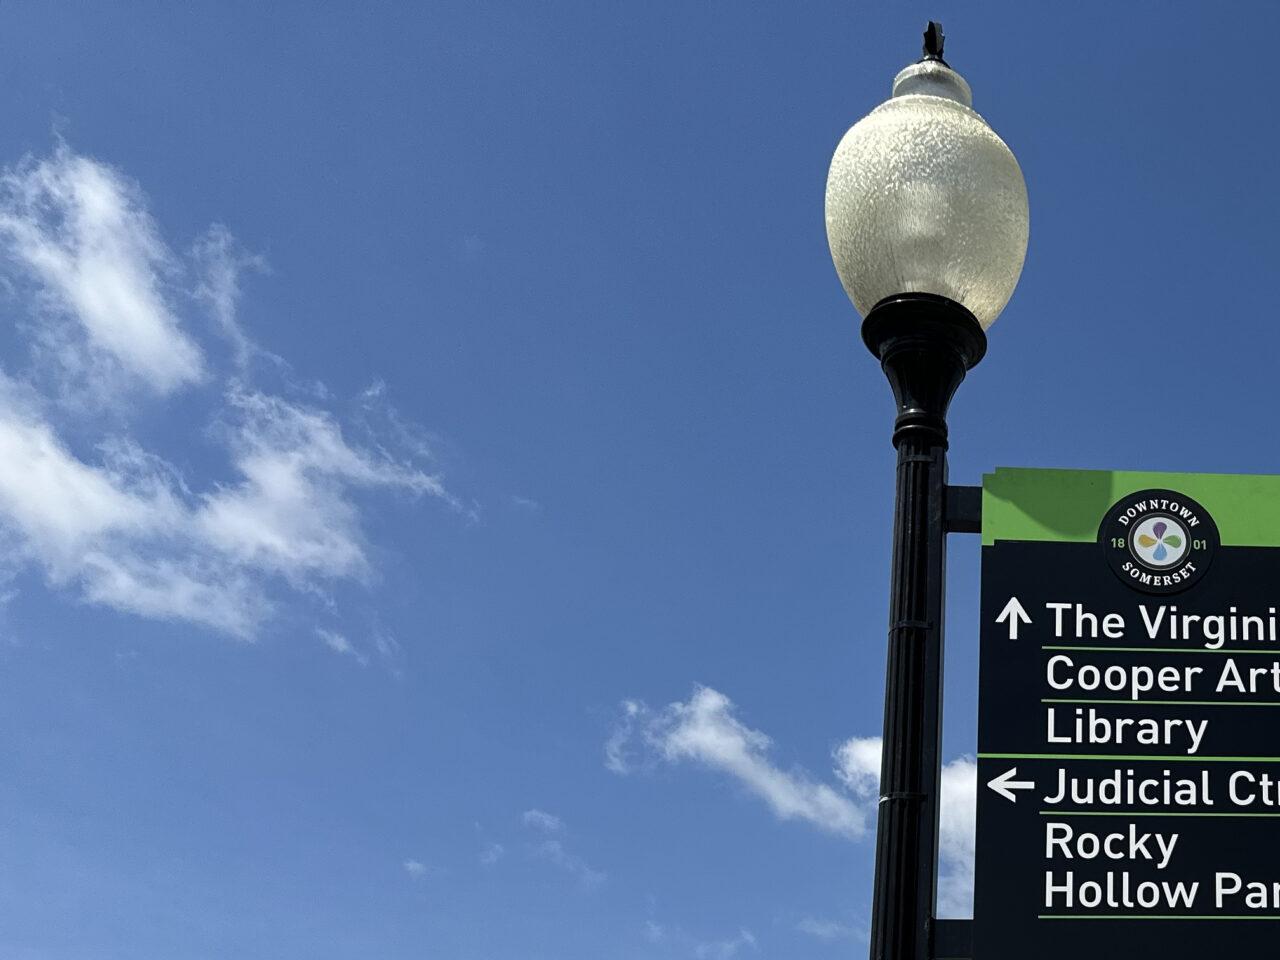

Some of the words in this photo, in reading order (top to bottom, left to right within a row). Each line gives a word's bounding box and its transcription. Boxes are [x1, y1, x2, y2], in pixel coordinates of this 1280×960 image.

[1118, 499, 1200, 527] DOWNTOWN
[1111, 538, 1125, 549] 18
[1193, 540, 1207, 550] 01
[1122, 561, 1197, 586] SOMERSET
[1046, 602, 1125, 638] The
[1047, 655, 1203, 700] Cooper
[1047, 708, 1208, 754] Library
[1043, 768, 1214, 806] Judicial
[1045, 822, 1179, 869] Rocky
[1045, 870, 1200, 908] Hollow
